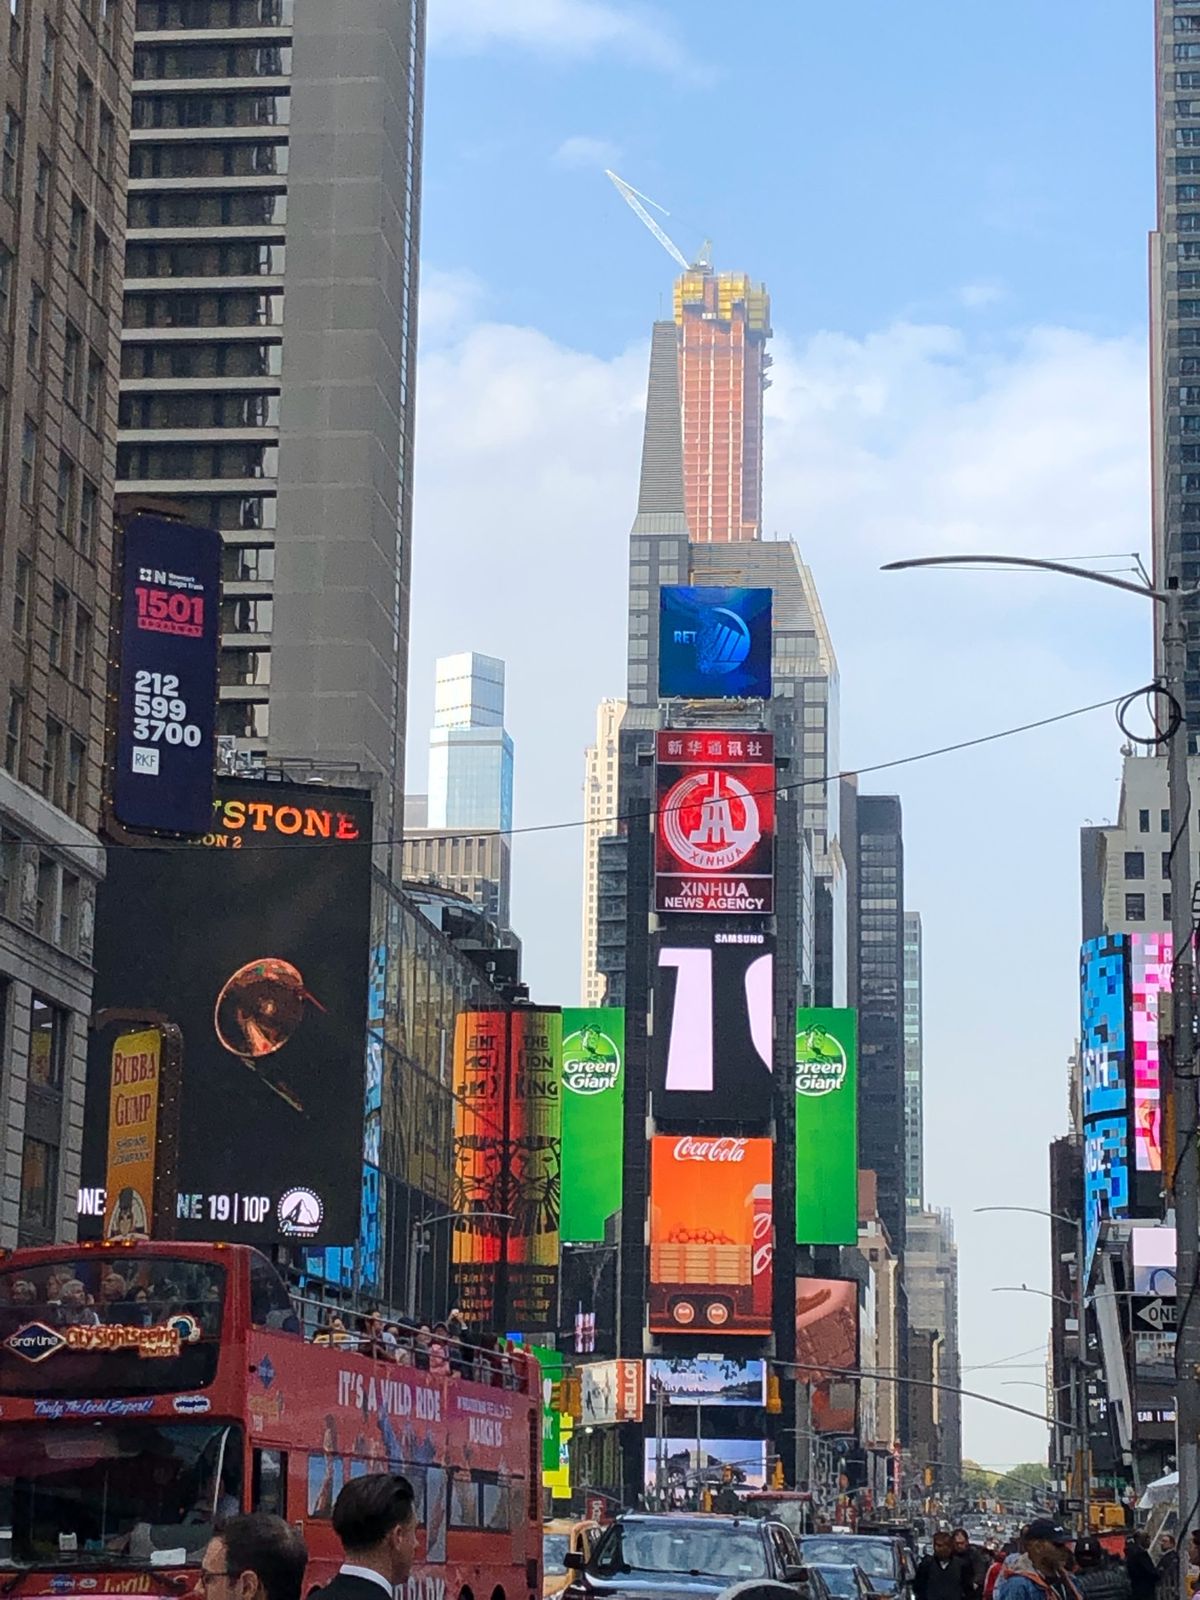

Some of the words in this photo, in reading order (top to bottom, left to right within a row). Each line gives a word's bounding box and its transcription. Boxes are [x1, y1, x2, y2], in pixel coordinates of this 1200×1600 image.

[135, 586, 204, 625] 1501
[135, 670, 179, 697] 212
[134, 693, 187, 722] 599
[133, 717, 202, 747] 3700
[667, 740, 763, 757] 新华通讯社
[135, 753, 157, 767] RKF
[232, 835, 242, 849] 2
[689, 848, 744, 866] XINHUA
[680, 881, 749, 897] XINHUA
[664, 896, 705, 909] NEWS
[707, 897, 764, 910] AGENCY
[714, 934, 764, 944] SAMSUNG
[113, 1052, 156, 1086] BUBBA
[564, 1059, 617, 1074] Green
[569, 1073, 617, 1089] Giant
[796, 1074, 844, 1090] Giant
[115, 1094, 151, 1127] GUMP
[208, 1195, 230, 1221] 19
[338, 1370, 364, 1409] IT'S
[367, 1376, 378, 1412] A
[380, 1379, 412, 1417] WILD
[415, 1386, 441, 1422] RIDE
